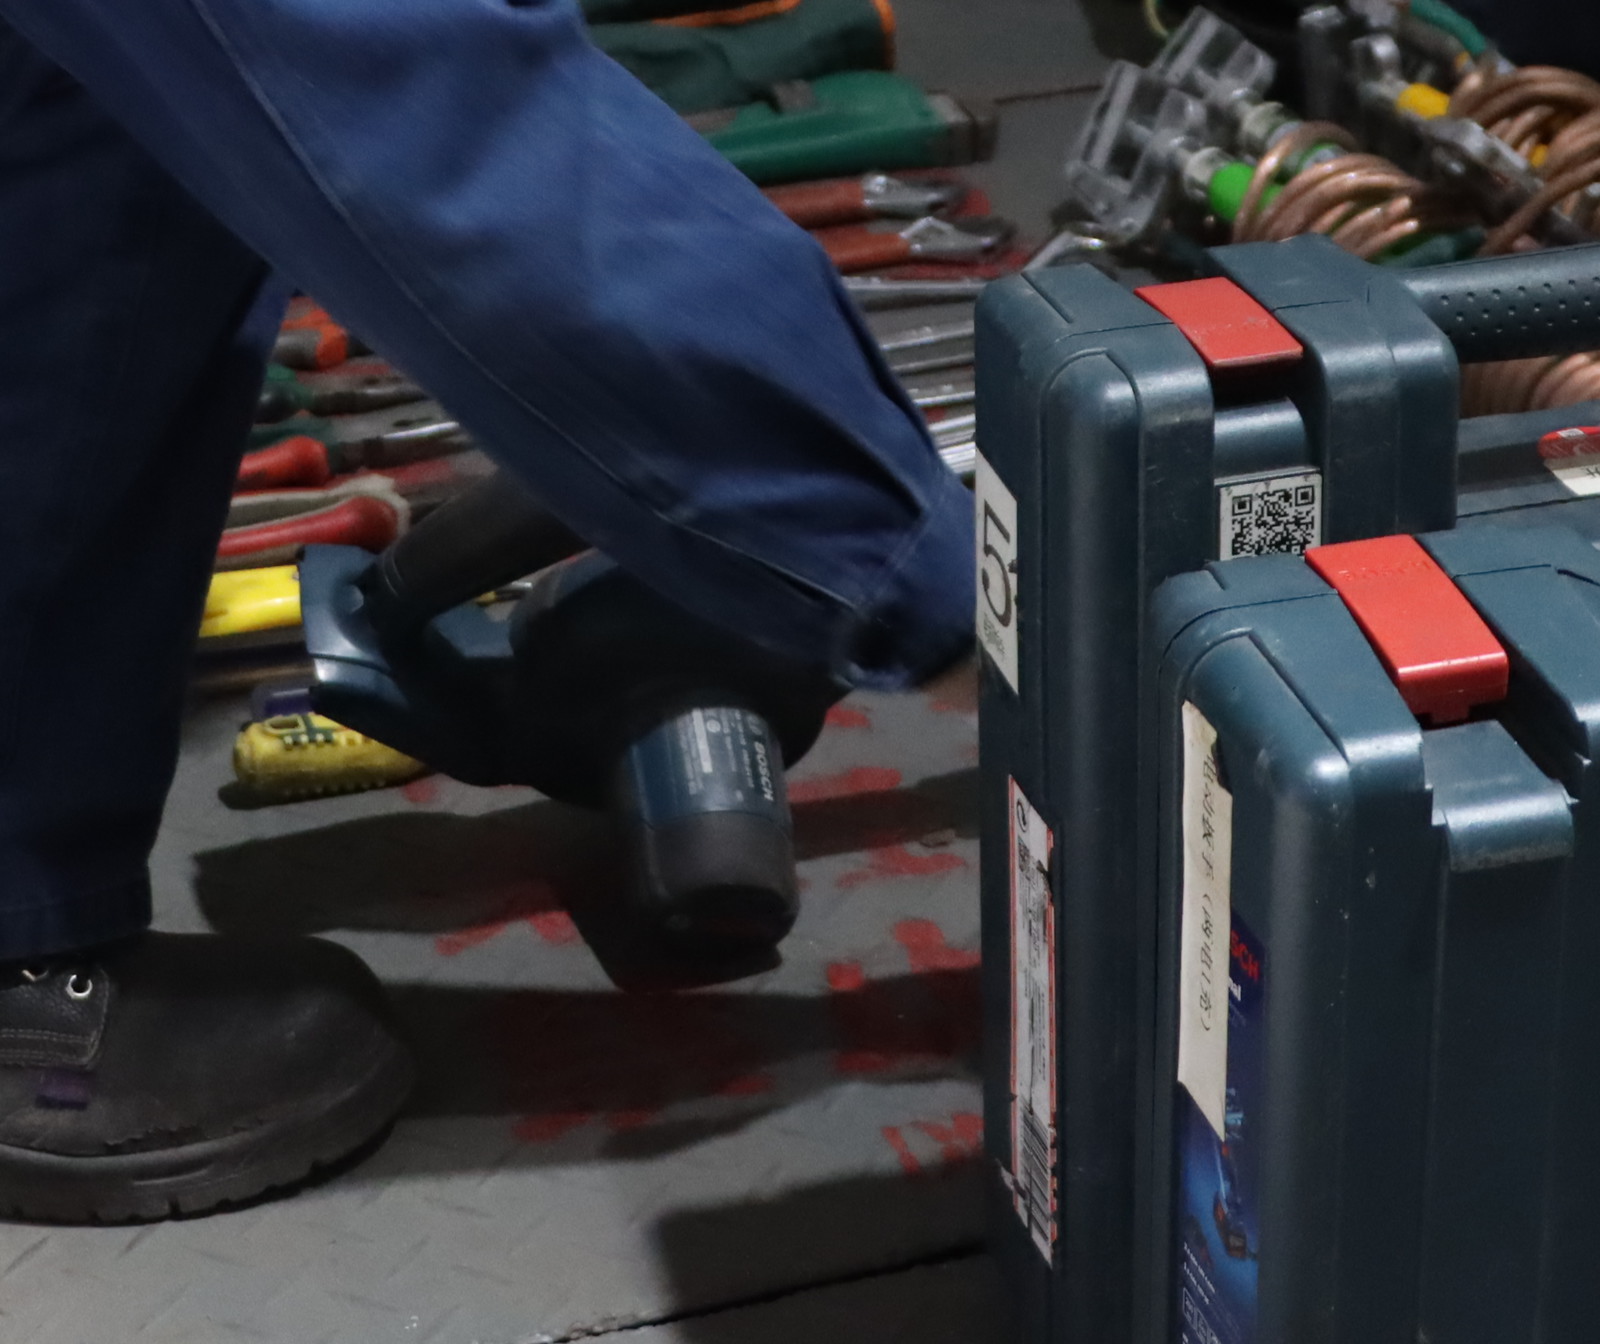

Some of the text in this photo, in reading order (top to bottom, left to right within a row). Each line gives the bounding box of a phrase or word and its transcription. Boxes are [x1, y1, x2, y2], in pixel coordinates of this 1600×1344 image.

[982, 500, 1012, 628] 5
[755, 742, 774, 800] BOSCH
[1230, 930, 1259, 981] SCH
